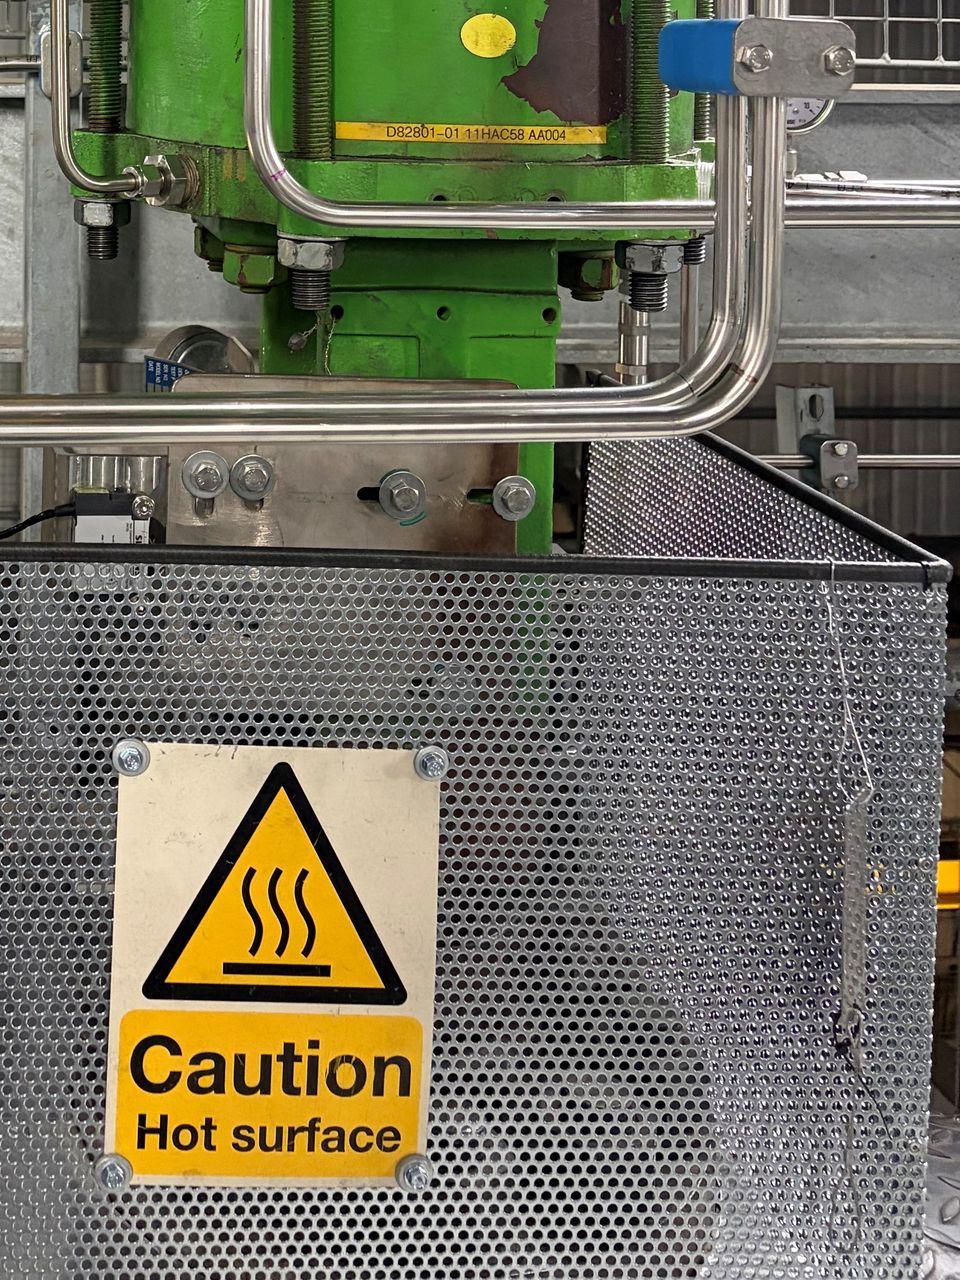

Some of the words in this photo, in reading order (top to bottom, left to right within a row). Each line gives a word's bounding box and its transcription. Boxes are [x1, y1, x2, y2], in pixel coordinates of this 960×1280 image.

[386, 125, 460, 139] D82801-01
[466, 127, 525, 140] 11HAC58
[528, 128, 566, 141] AA004
[129, 1034, 412, 1098] Caution
[136, 1113, 218, 1151] Hot
[231, 1117, 402, 1153] surface
